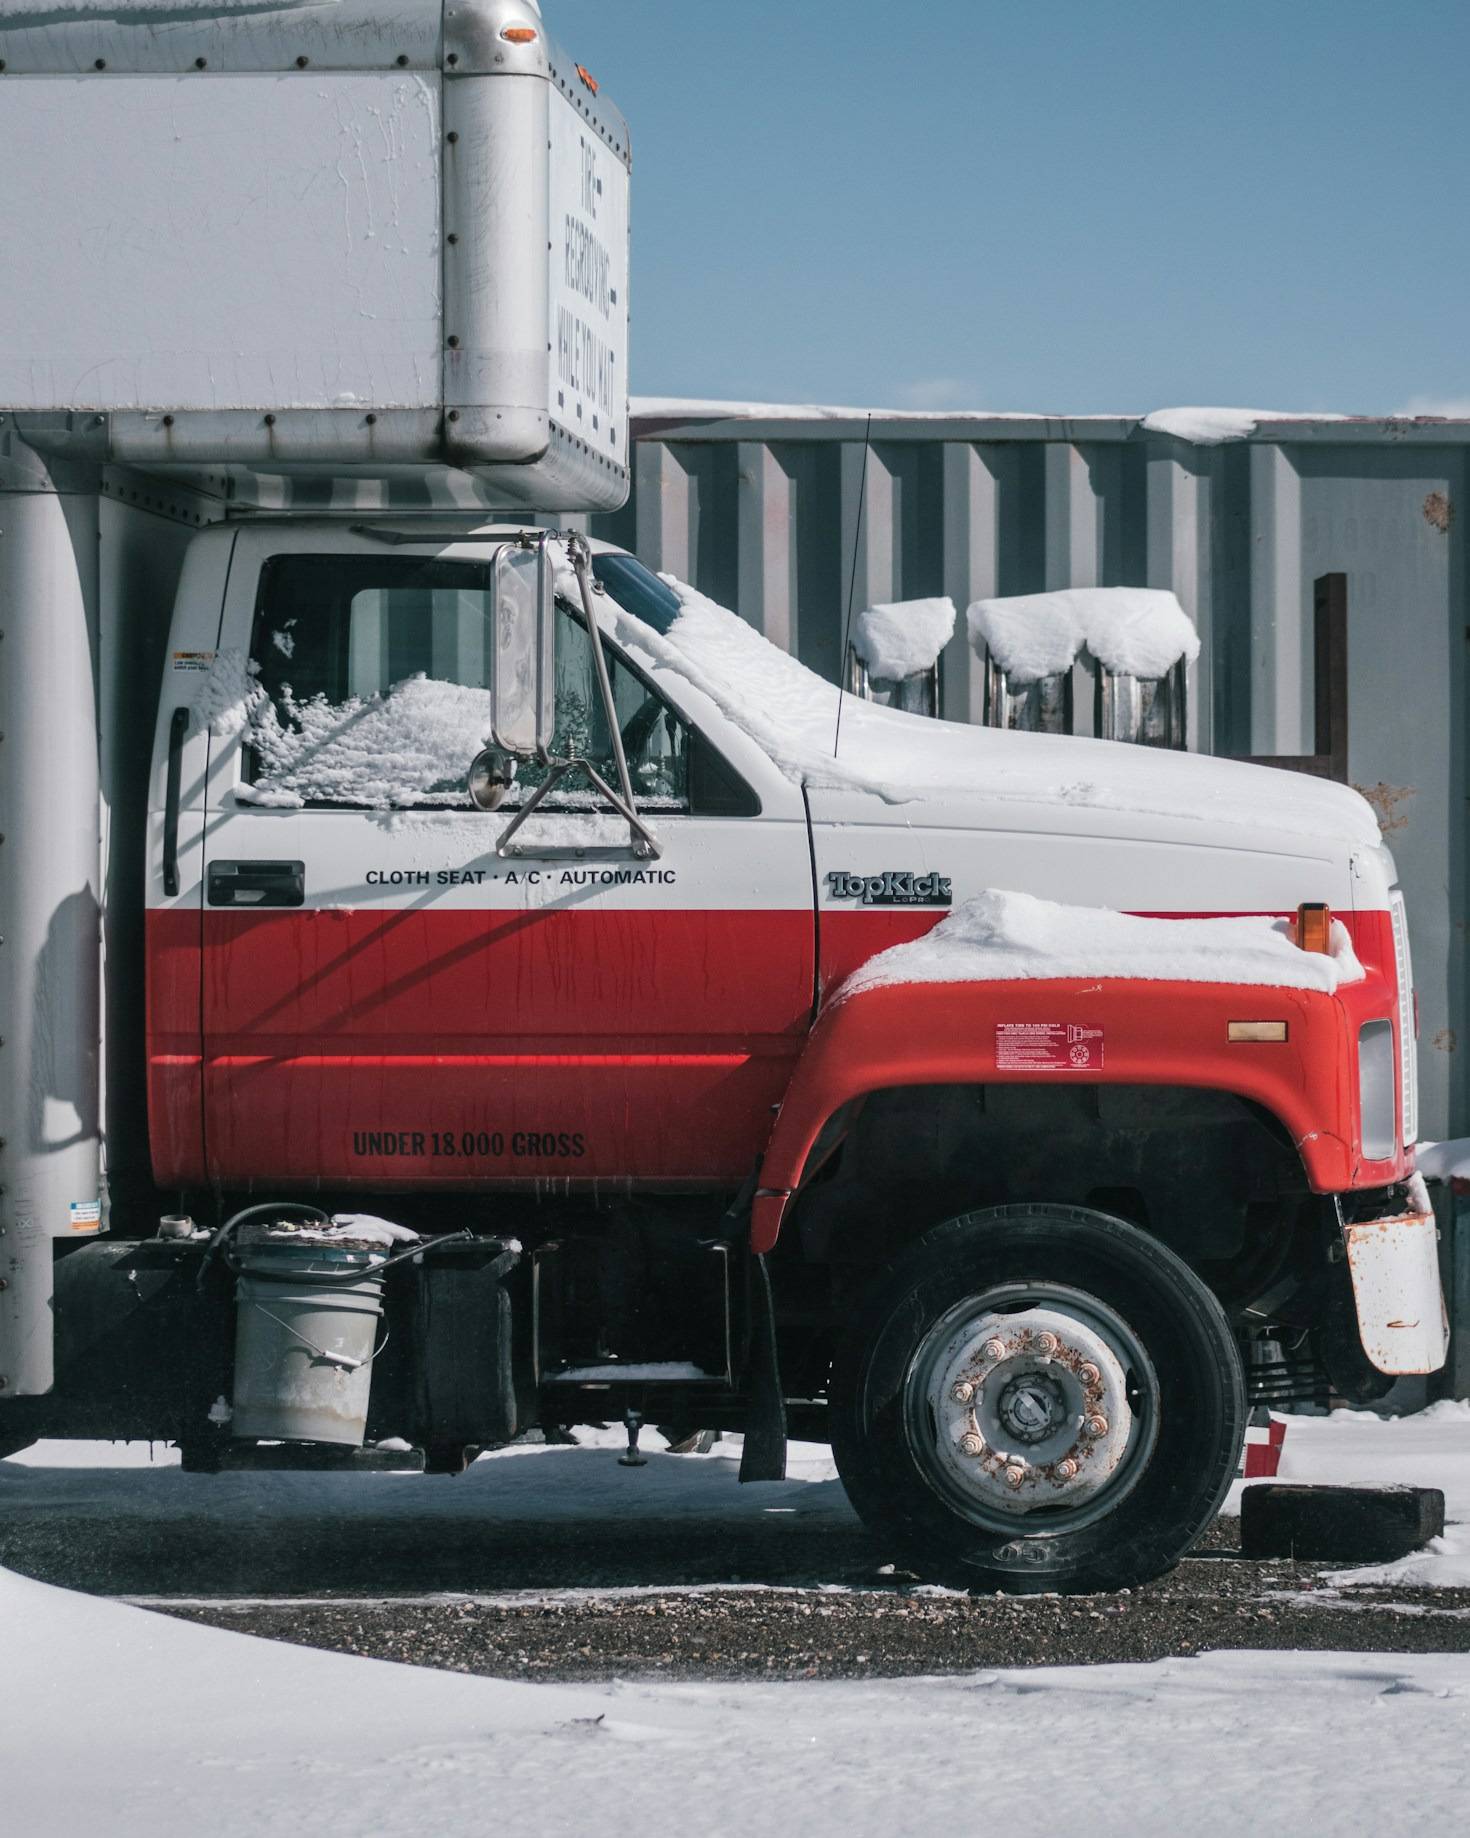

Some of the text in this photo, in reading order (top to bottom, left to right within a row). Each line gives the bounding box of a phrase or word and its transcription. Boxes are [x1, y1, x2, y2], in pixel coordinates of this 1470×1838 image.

[558, 303, 614, 419] WHILE YOU WAIT
[365, 870, 677, 885] CLOTH SEAT A/C AUTOMATIC
[829, 871, 952, 904] TopKick
[353, 1132, 585, 1158] UNDER 18,000 GROSS
